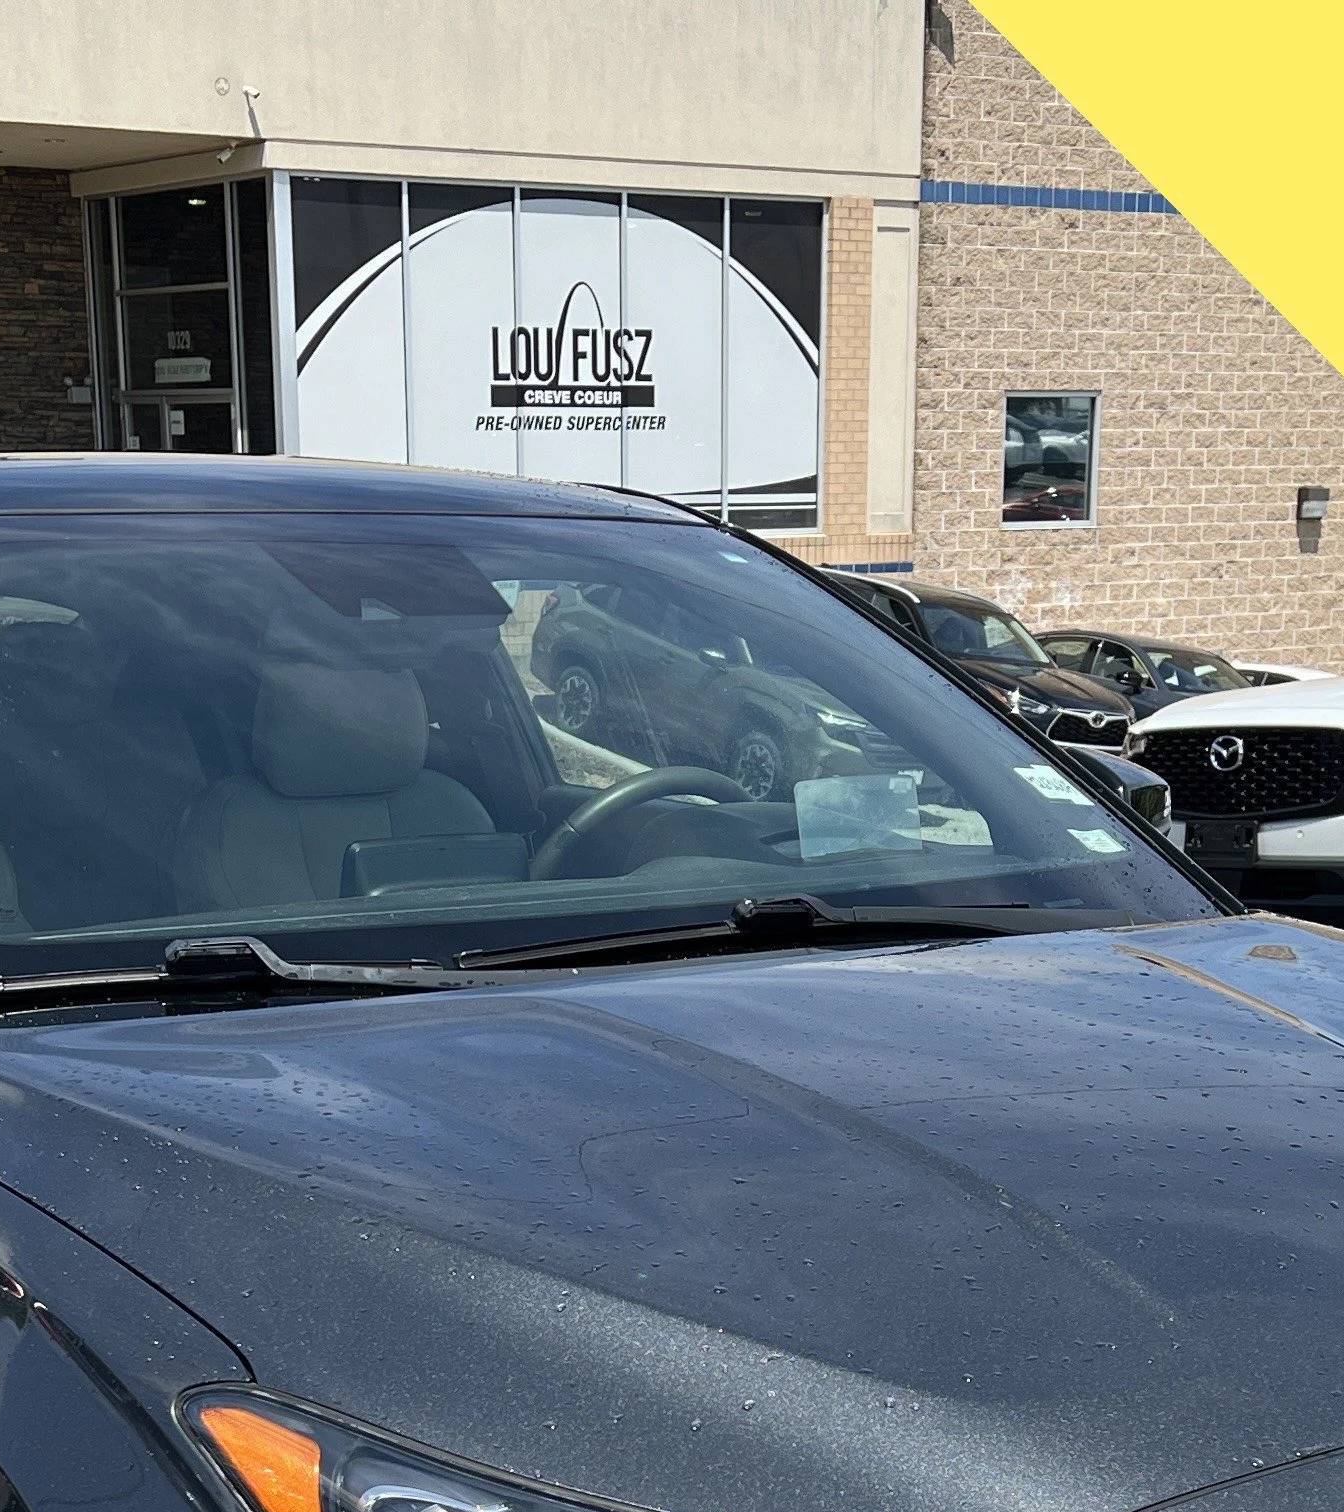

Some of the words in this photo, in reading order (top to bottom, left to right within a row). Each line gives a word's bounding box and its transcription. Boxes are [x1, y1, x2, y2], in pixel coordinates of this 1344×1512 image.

[492, 326, 554, 382] LOU
[572, 328, 653, 382] FUSZ
[524, 390, 571, 404] CREVE
[574, 391, 622, 404] COEUR
[475, 415, 562, 431] PRE-OWNED
[567, 415, 666, 431] SUPERCENTER
